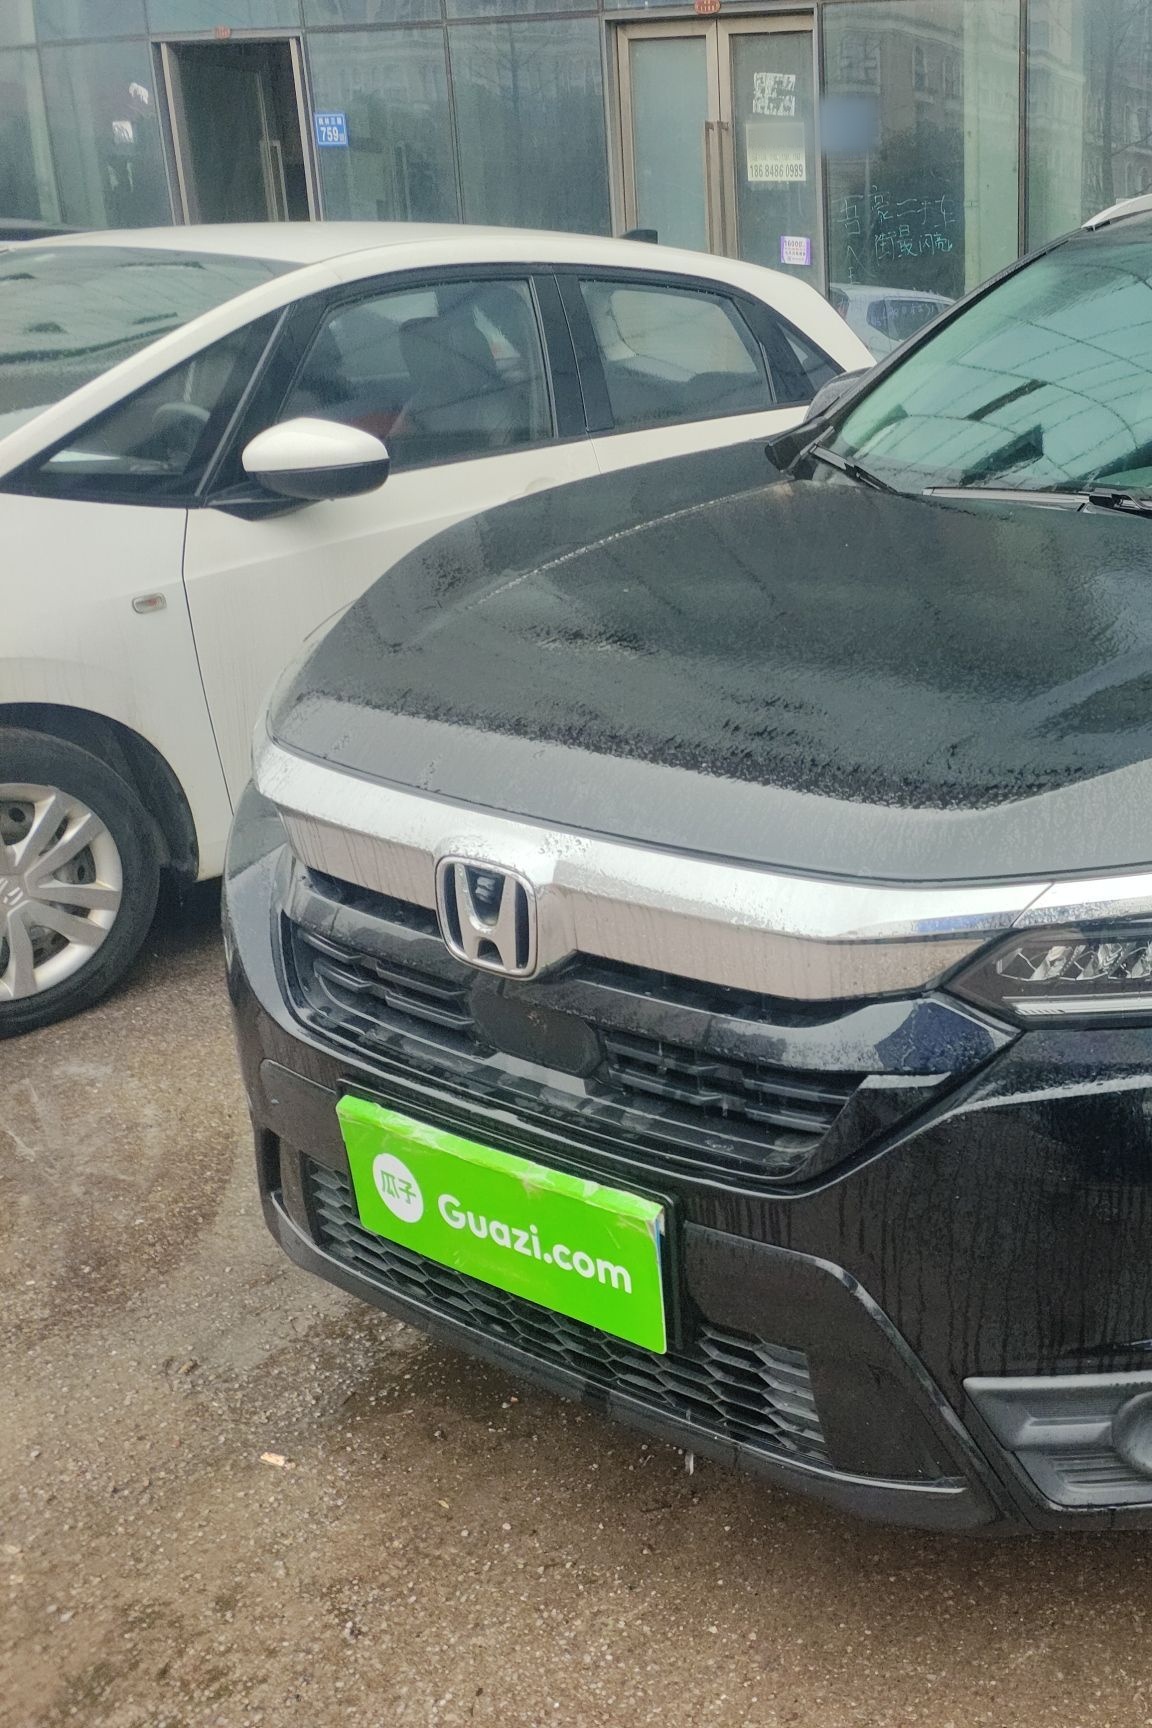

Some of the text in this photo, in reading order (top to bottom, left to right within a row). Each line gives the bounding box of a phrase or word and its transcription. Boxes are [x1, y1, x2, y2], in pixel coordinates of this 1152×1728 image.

[750, 163, 803, 178] 186 8486 0989
[380, 1170, 417, 1204] 瓜子
[437, 1193, 632, 1294] Guazi.com
